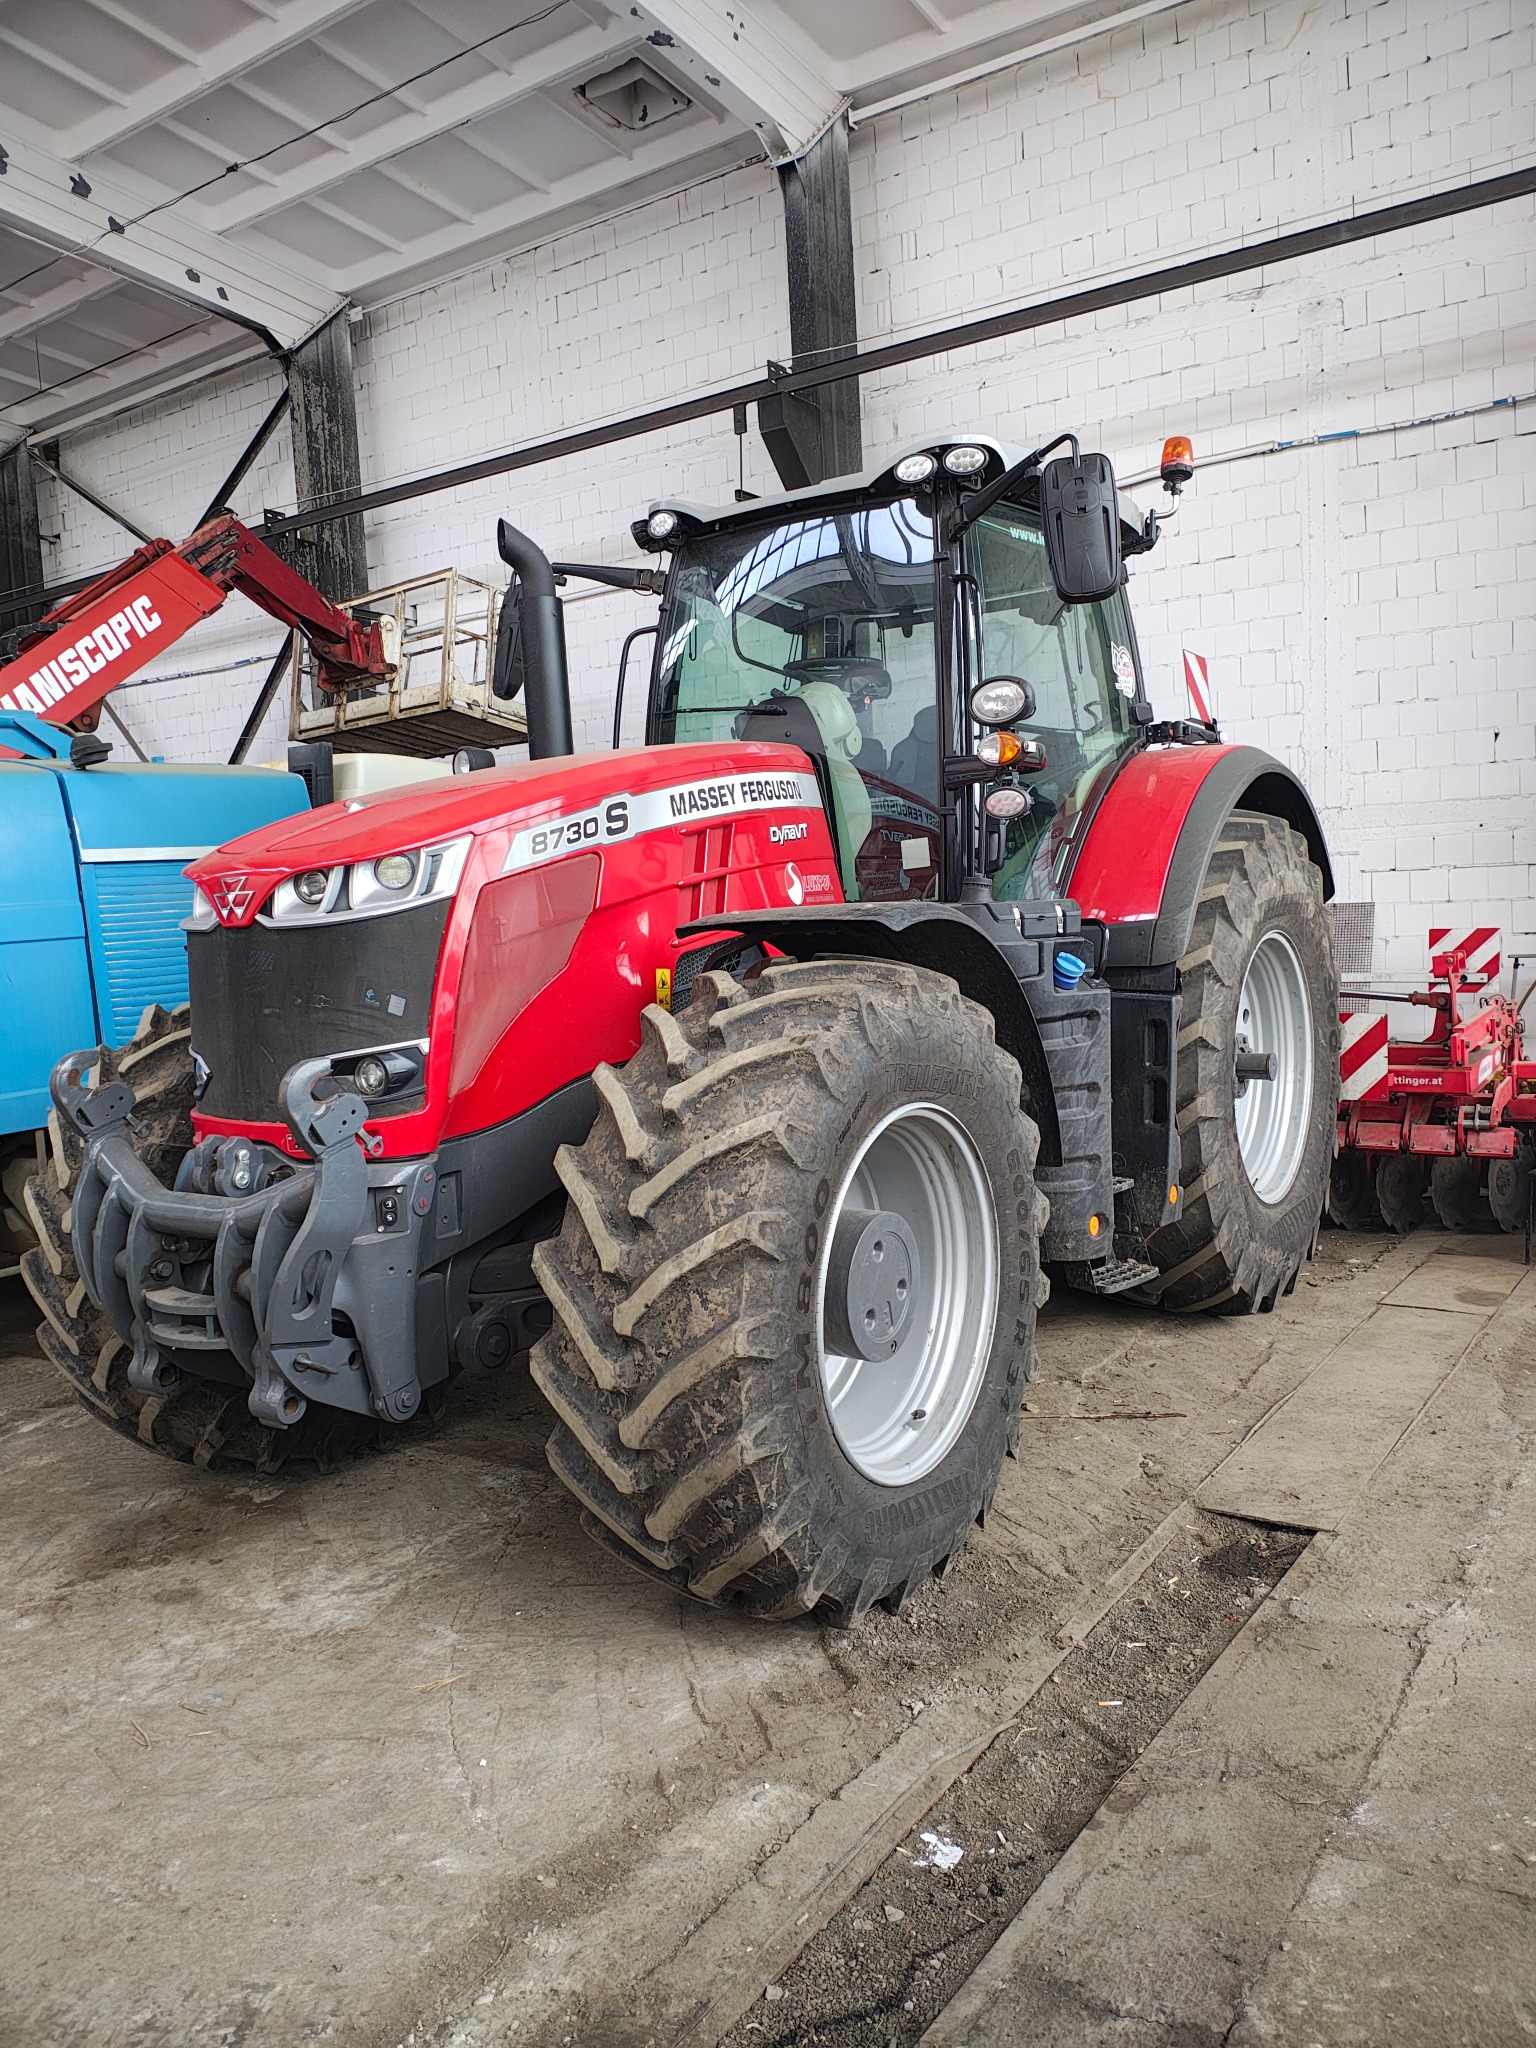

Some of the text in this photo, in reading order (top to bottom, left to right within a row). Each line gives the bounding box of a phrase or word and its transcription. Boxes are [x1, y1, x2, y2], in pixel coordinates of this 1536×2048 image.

[531, 780, 803, 856] 8730 S MASSEY FERGUSON
[769, 823, 808, 846] DynaVT
[884, 1062, 986, 1101] TRELLEBORG
[1393, 1075, 1443, 1087] ttinger.at
